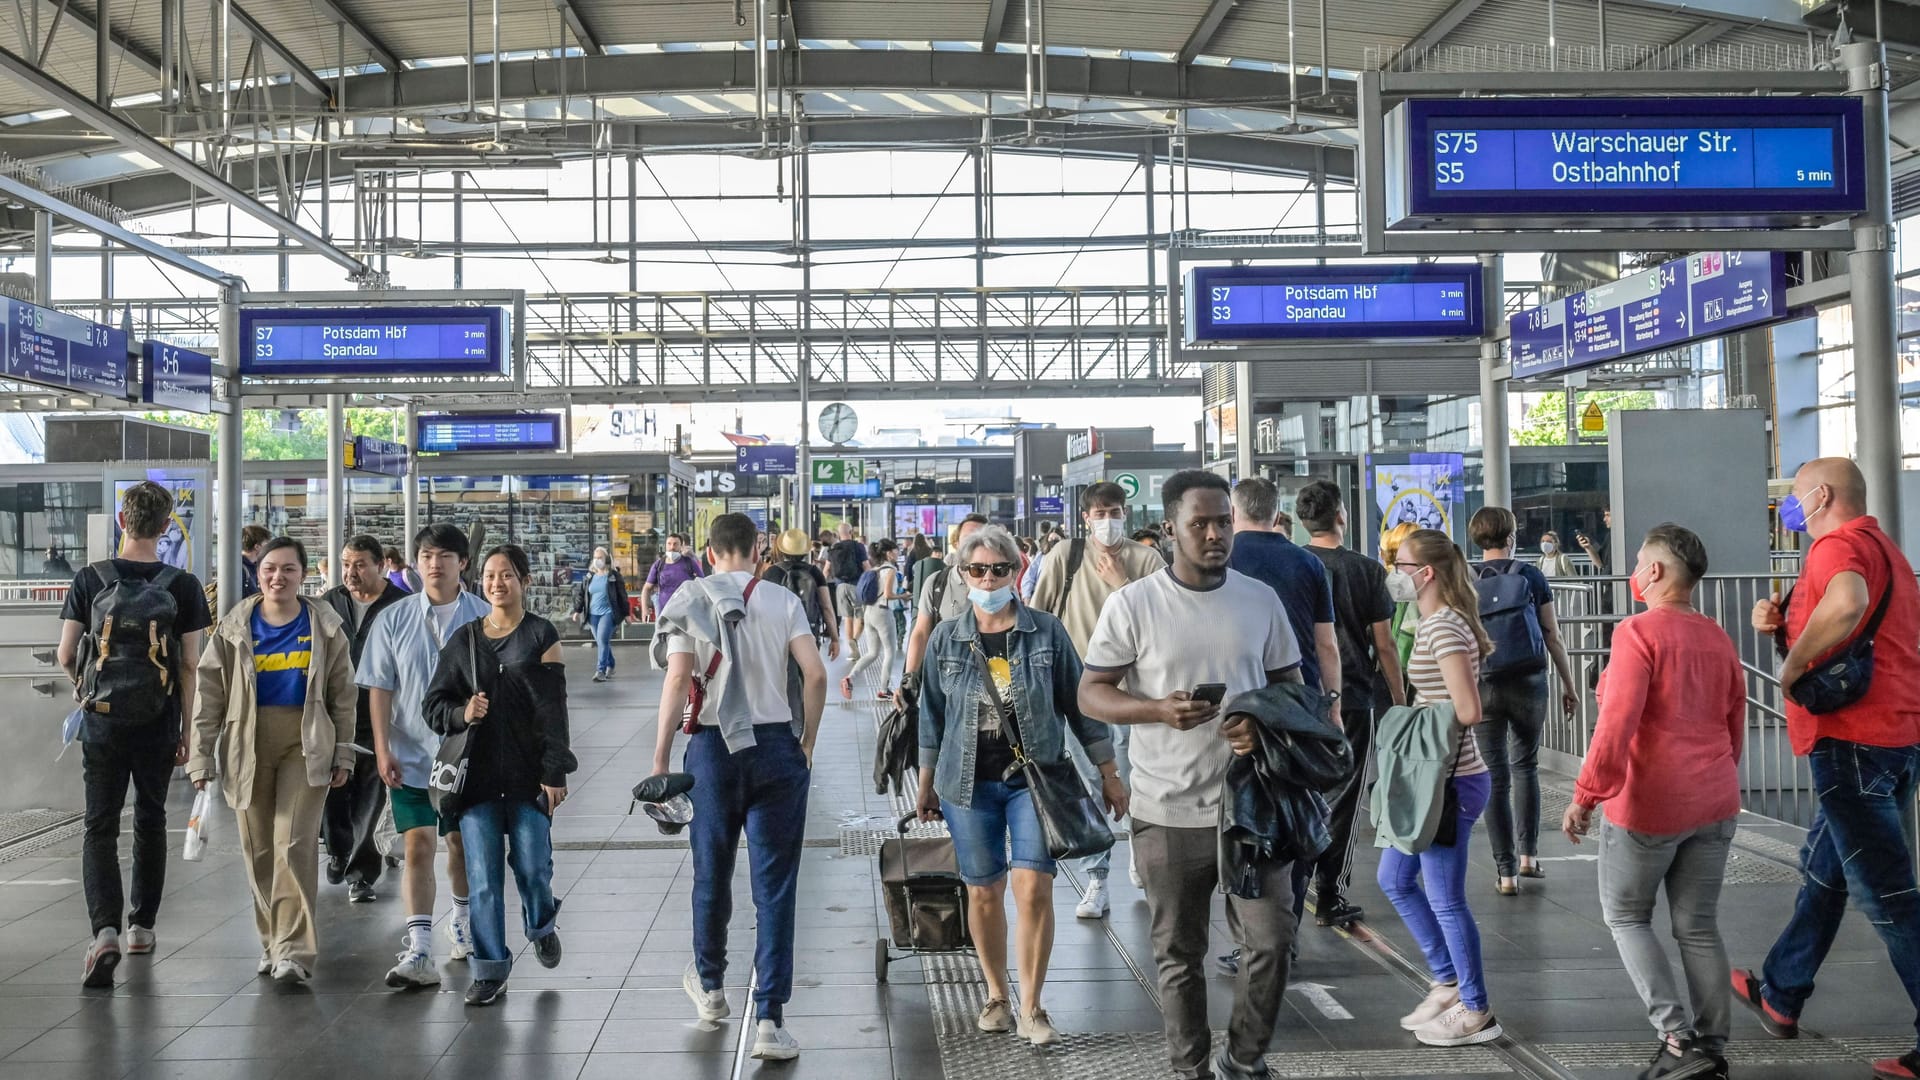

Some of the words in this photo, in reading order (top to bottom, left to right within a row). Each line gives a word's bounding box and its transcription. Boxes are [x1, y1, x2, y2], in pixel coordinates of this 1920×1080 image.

[1436, 132, 1478, 154] S75
[1552, 131, 1689, 154] Warschauer
[1698, 131, 1737, 153] Str.
[1437, 162, 1465, 183] S5
[1552, 160, 1681, 183] Ostbahnhof
[1797, 170, 1805, 181] 5
[1809, 169, 1832, 181] min
[1660, 267, 1675, 289] 3-4
[1212, 287, 1231, 301] S7
[1285, 286, 1348, 300] Potsdam
[1353, 285, 1378, 300] Hbf
[1440, 290, 1446, 298] 3
[1448, 290, 1463, 298] min
[1212, 306, 1231, 320] S3
[1286, 305, 1346, 322] Spandau
[1441, 309, 1446, 317] 4
[1448, 308, 1464, 317] min
[1573, 296, 1586, 316] 5-6
[19, 306, 33, 327] 5-6
[256, 327, 273, 340] S7
[323, 326, 380, 340] Potsdam
[385, 326, 407, 339] Hbf
[471, 330, 485, 338] min
[256, 344, 273, 357] S3
[323, 343, 378, 359] Spandau
[471, 347, 485, 355] min
[162, 348, 179, 376] 5-6
[740, 447, 747, 457] 8
